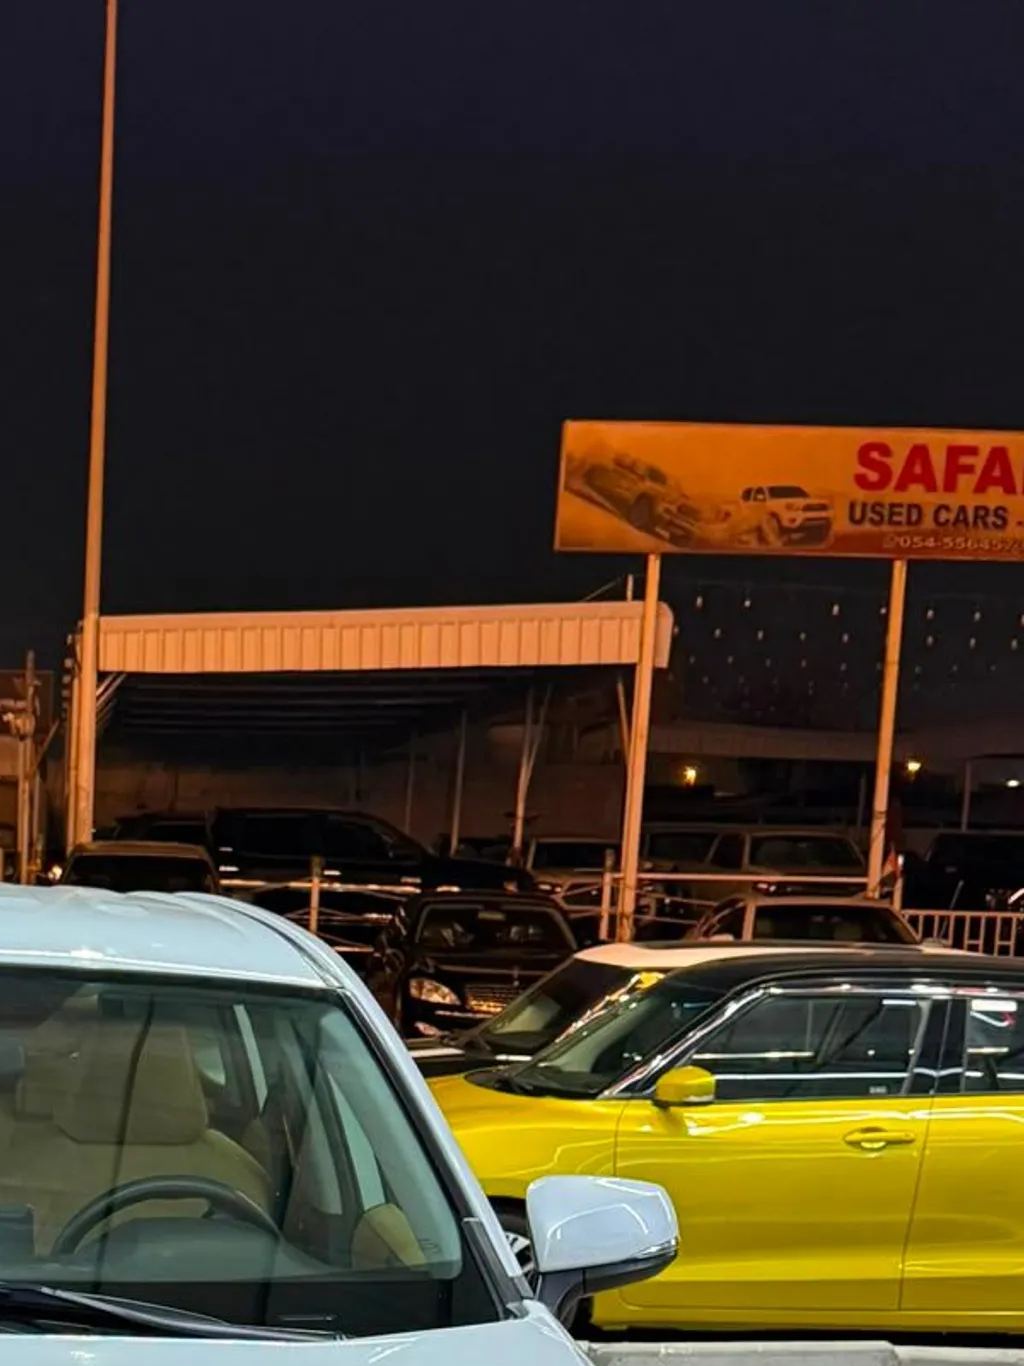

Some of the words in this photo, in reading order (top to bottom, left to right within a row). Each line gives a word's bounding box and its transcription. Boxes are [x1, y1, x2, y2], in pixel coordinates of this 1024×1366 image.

[853, 441, 1024, 494] SAFA
[848, 502, 923, 526] USED
[932, 504, 1009, 530] CARS
